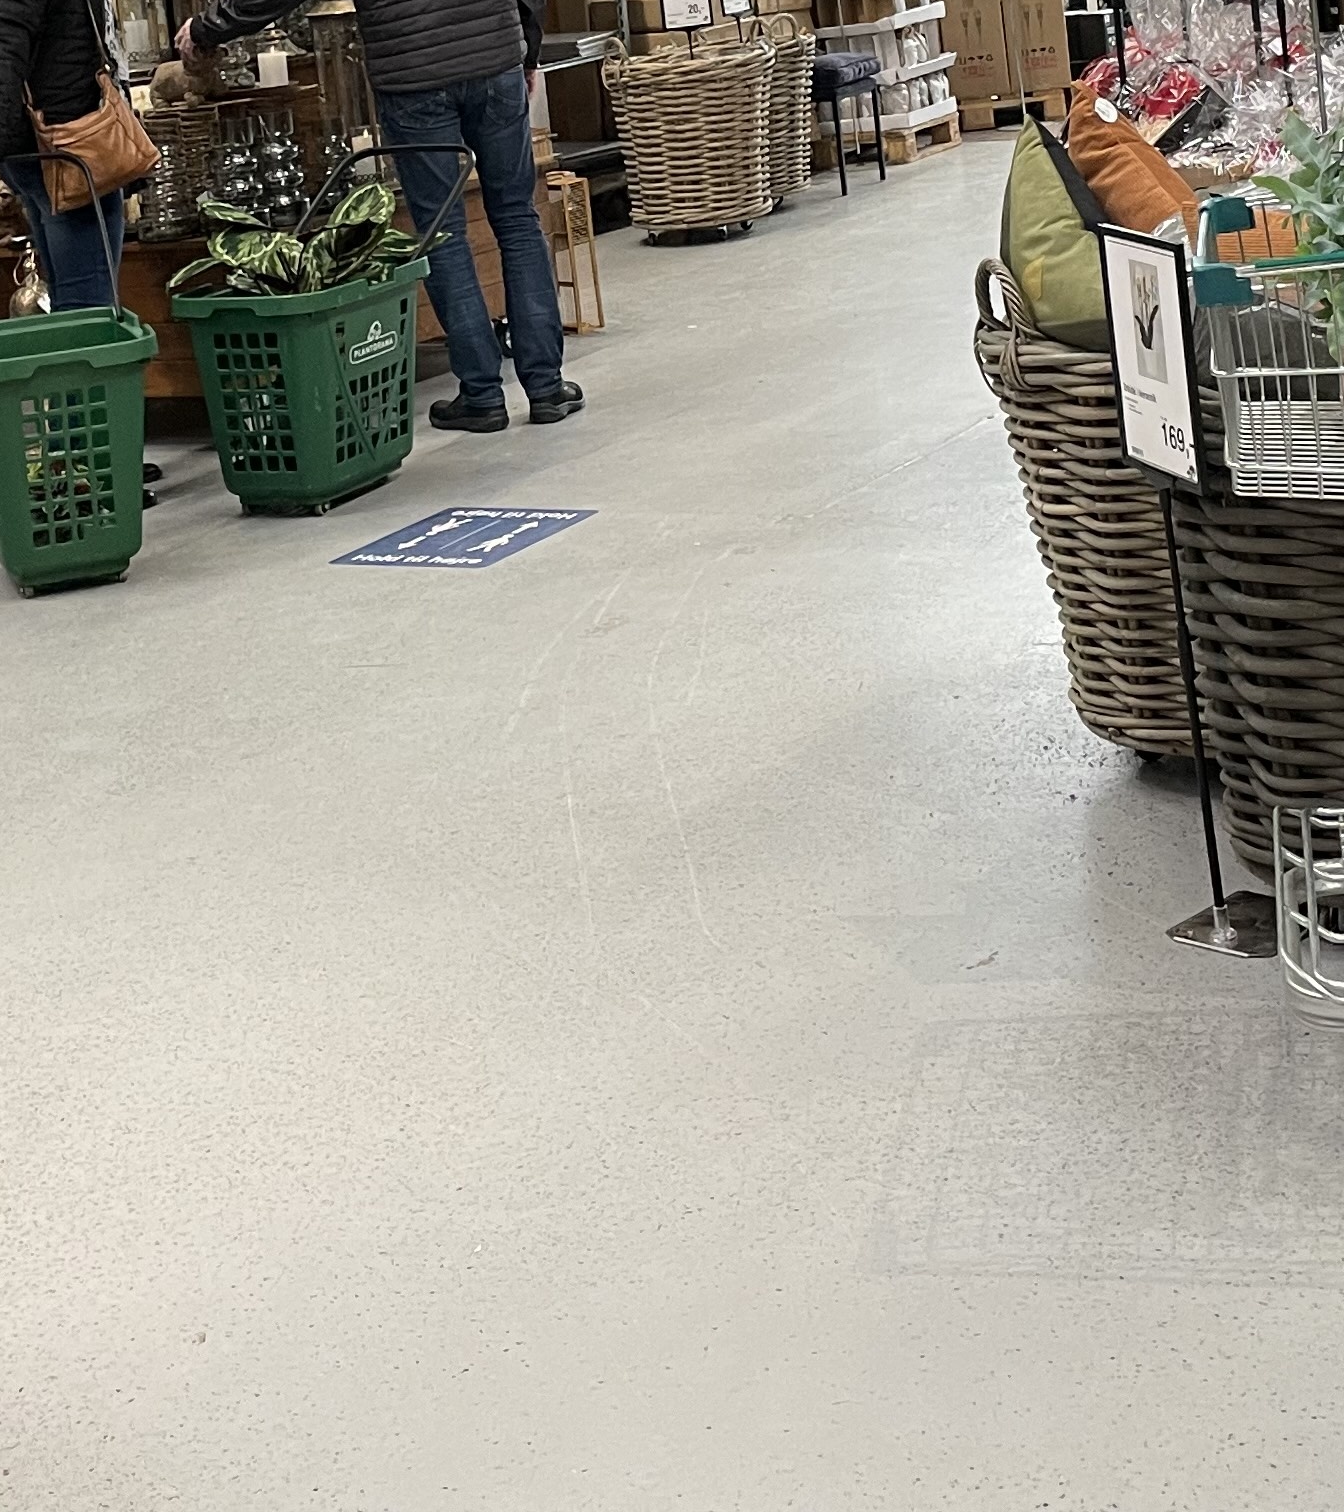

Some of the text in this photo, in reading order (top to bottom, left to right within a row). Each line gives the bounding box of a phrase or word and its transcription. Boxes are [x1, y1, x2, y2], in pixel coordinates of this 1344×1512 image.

[501, 511, 527, 519] til
[527, 511, 577, 520] Hold
[351, 553, 403, 563] Hold
[404, 555, 429, 563] til
